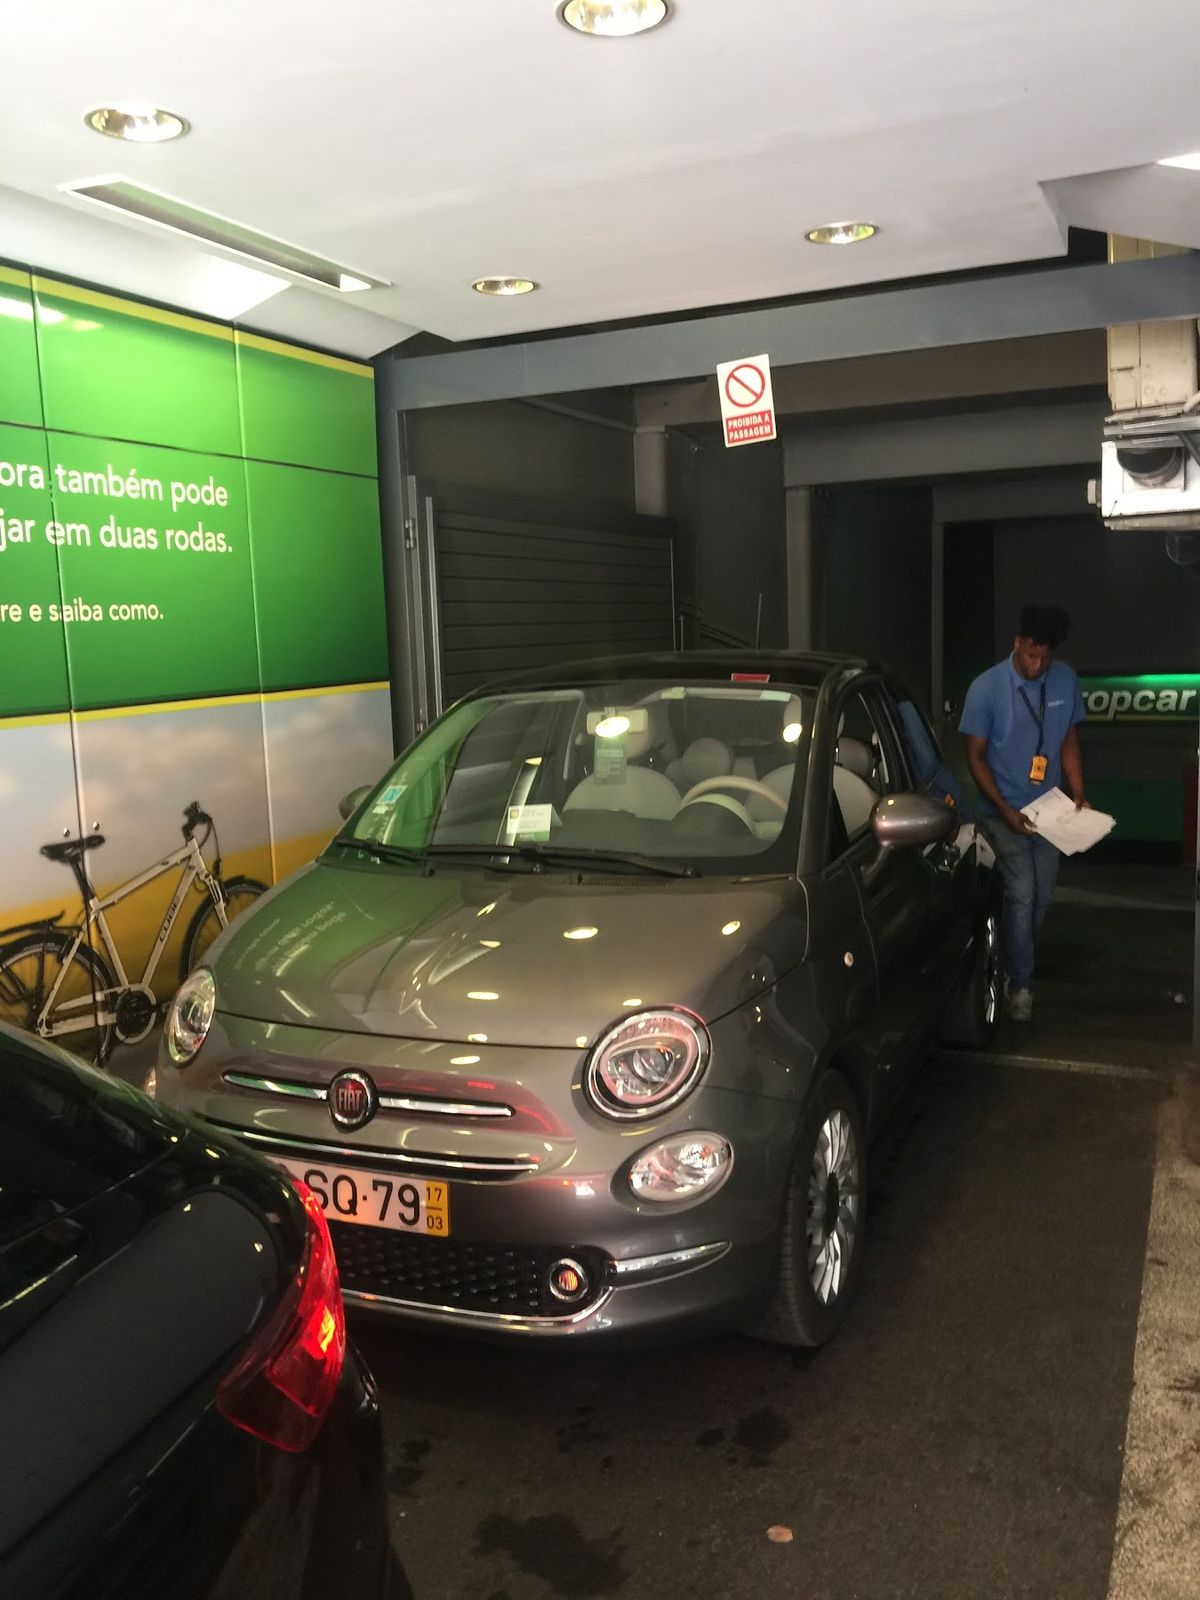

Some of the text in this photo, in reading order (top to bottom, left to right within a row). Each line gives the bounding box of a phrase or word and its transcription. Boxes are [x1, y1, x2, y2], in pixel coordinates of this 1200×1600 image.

[728, 413, 770, 429] PROIBIDA A
[729, 425, 771, 440] PASSAGEM
[0, 462, 228, 512] ora também pode
[45, 521, 91, 546] em
[100, 515, 158, 550] duas
[165, 521, 233, 553] rodas.
[29, 603, 42, 622] e
[49, 597, 103, 622] saiba
[109, 603, 164, 620] como.
[339, 1088, 362, 1111] FIAT
[426, 1187, 442, 1202] 17
[427, 1215, 443, 1230] 03
